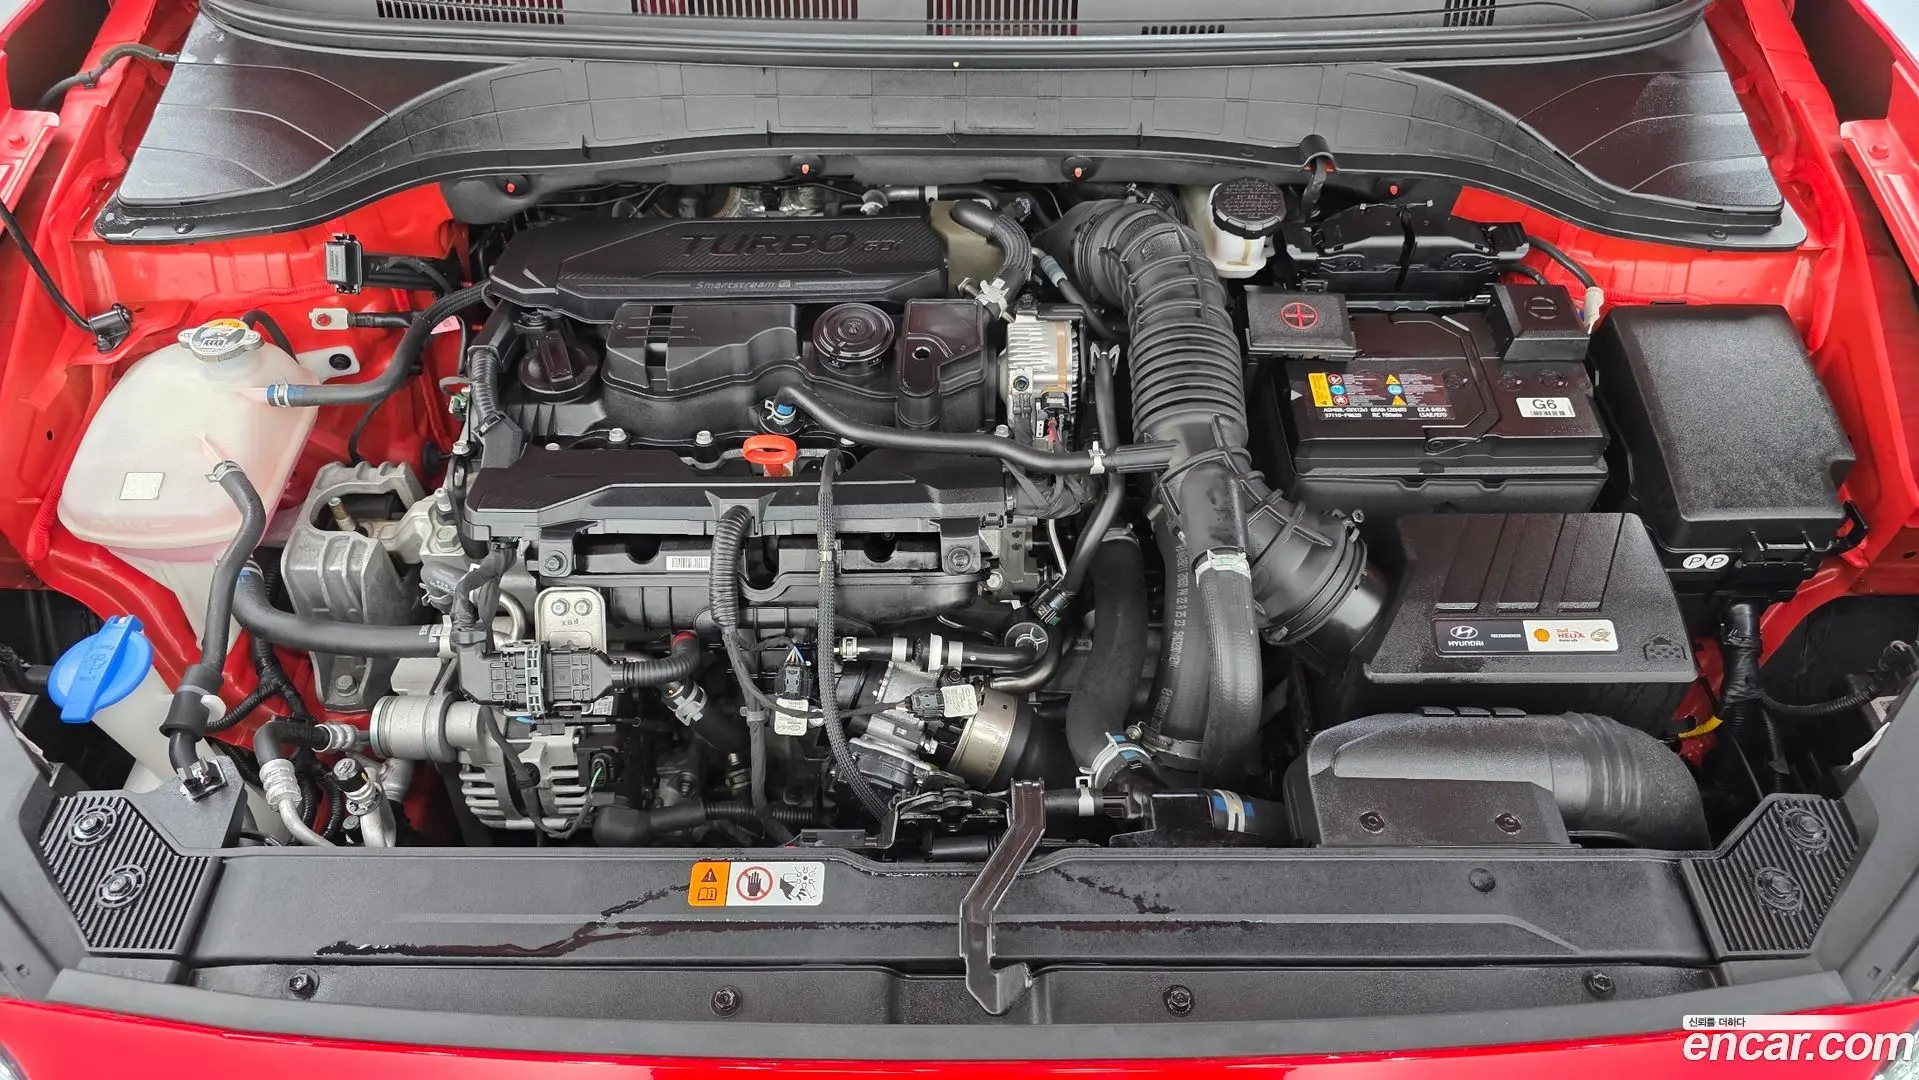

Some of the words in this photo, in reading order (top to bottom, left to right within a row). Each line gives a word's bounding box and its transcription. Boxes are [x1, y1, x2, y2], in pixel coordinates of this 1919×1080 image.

[680, 233, 854, 257] TURBO
[696, 281, 775, 290] Smartstream
[1532, 399, 1557, 410] G6
[1557, 631, 1585, 639] HELIX
